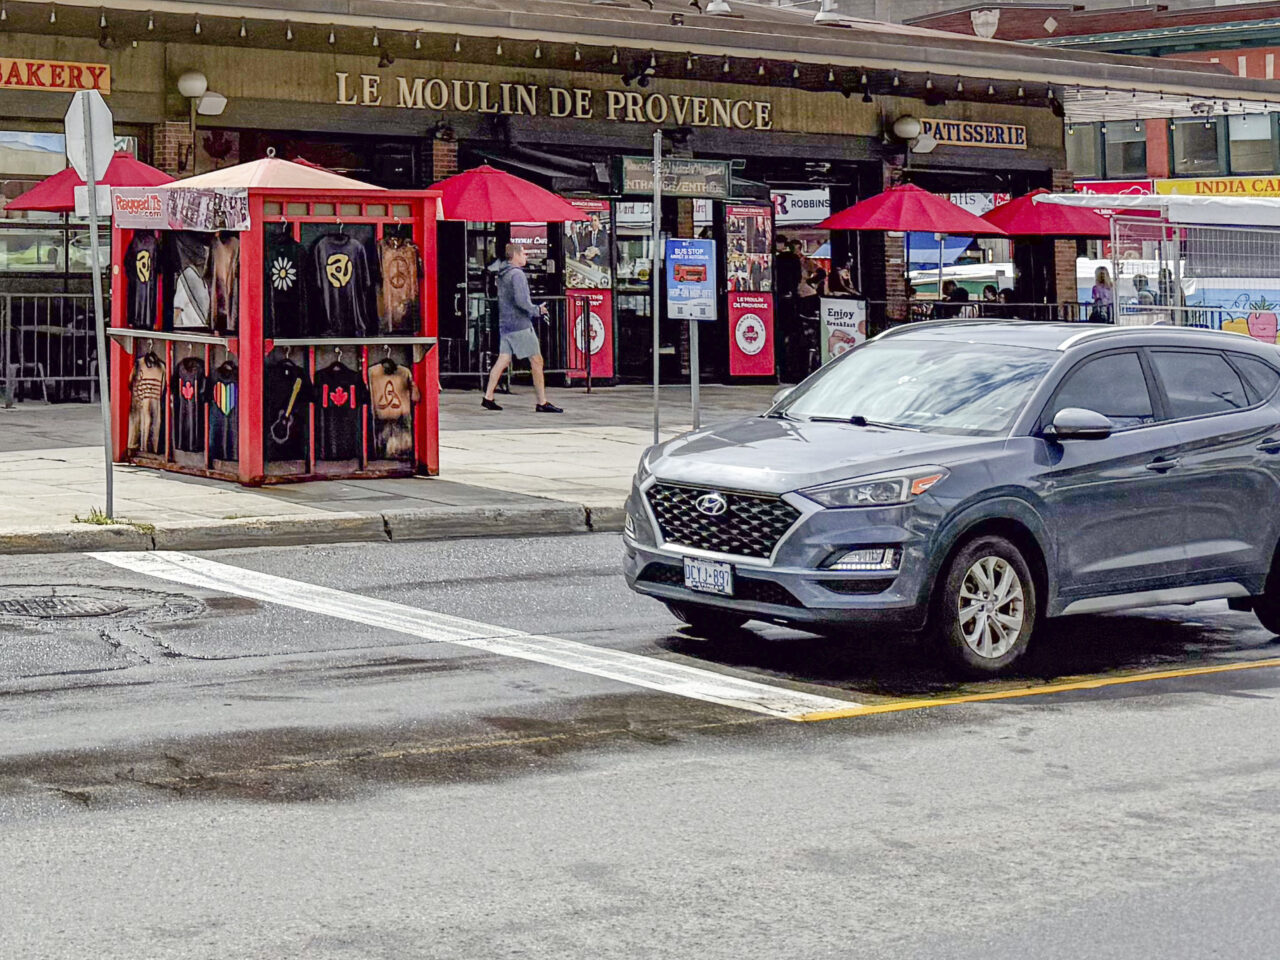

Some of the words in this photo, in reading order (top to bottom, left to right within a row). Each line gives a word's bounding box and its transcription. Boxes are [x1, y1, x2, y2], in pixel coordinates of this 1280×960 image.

[335, 72, 381, 106] LE
[396, 76, 538, 117] MOULIN
[550, 87, 593, 119] DE
[607, 90, 773, 131] PROVENCE
[922, 121, 1025, 145] PATISSERIE
[1195, 179, 1246, 194] INDIA
[791, 199, 831, 208] ROBBINS
[827, 307, 855, 320] Enjoy
[826, 320, 856, 328] Breakfast
